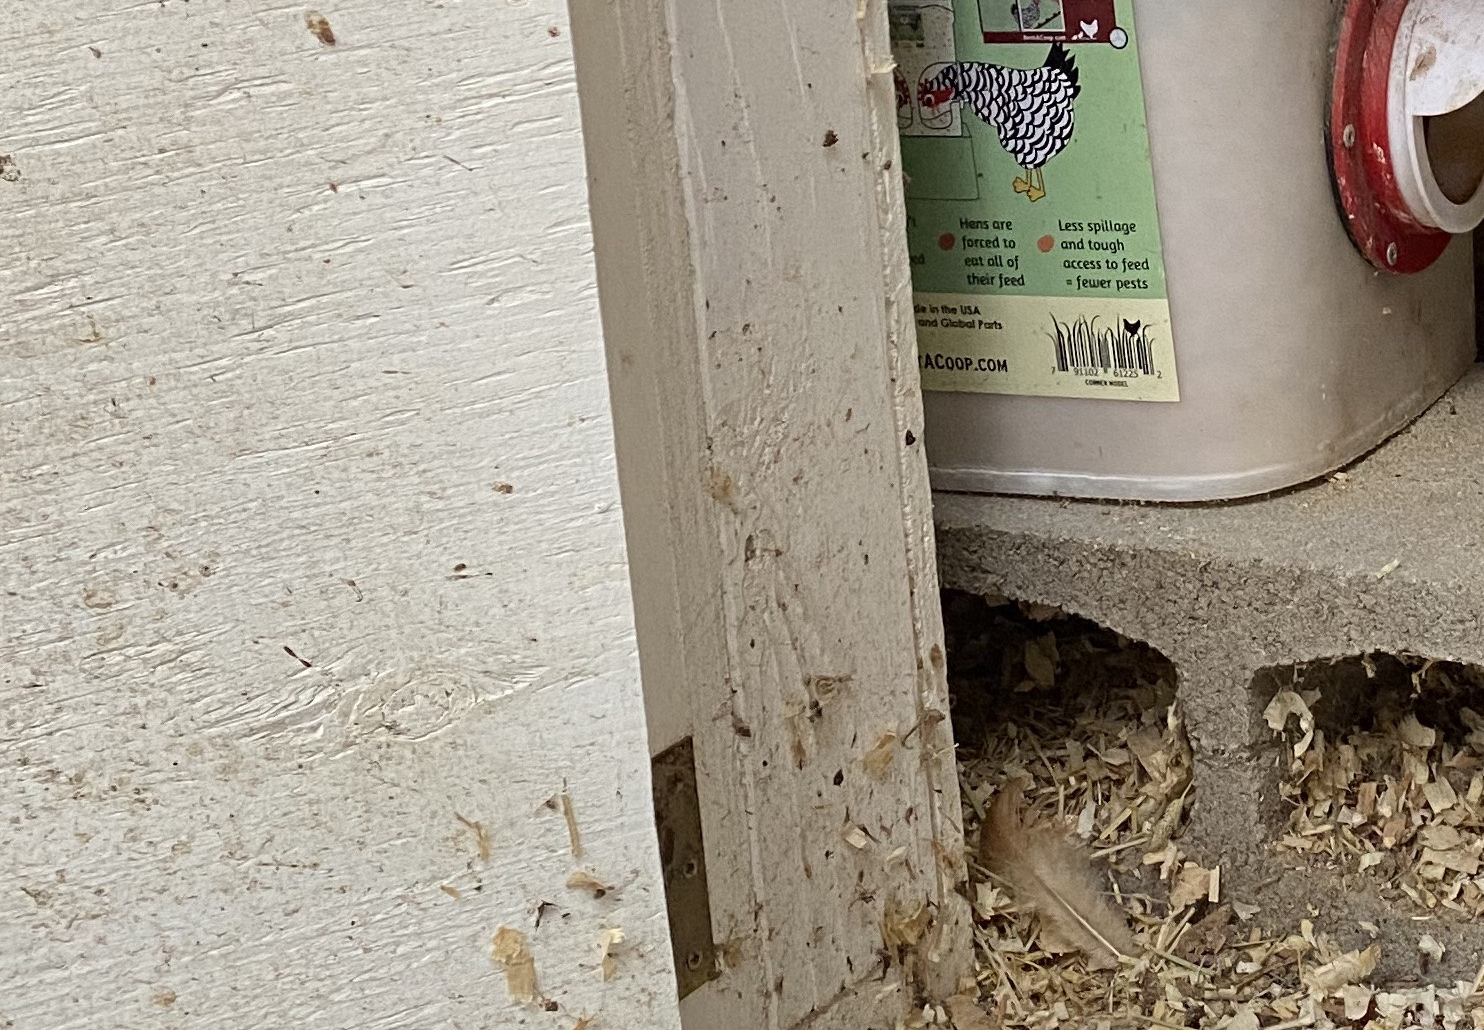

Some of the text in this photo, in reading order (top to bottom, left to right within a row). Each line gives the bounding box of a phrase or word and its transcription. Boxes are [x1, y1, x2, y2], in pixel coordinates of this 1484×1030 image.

[959, 218, 1013, 231] Hens are
[1058, 220, 1136, 235] Less spillage
[962, 235, 1016, 251] forced to
[1060, 238, 1125, 253] and tough
[965, 255, 1019, 270] eat all of
[1063, 257, 1149, 272] access to feed
[967, 273, 1025, 288] their feed
[1076, 276, 1111, 290] fewer
[1117, 278, 1149, 291] pests
[929, 304, 939, 314] in
[941, 305, 957, 315] the
[960, 305, 981, 315] USA
[918, 318, 1003, 330] and Global Parts
[1074, 367, 1099, 377] 91102
[1113, 370, 1138, 378] 61225
[1157, 371, 1163, 379] 2
